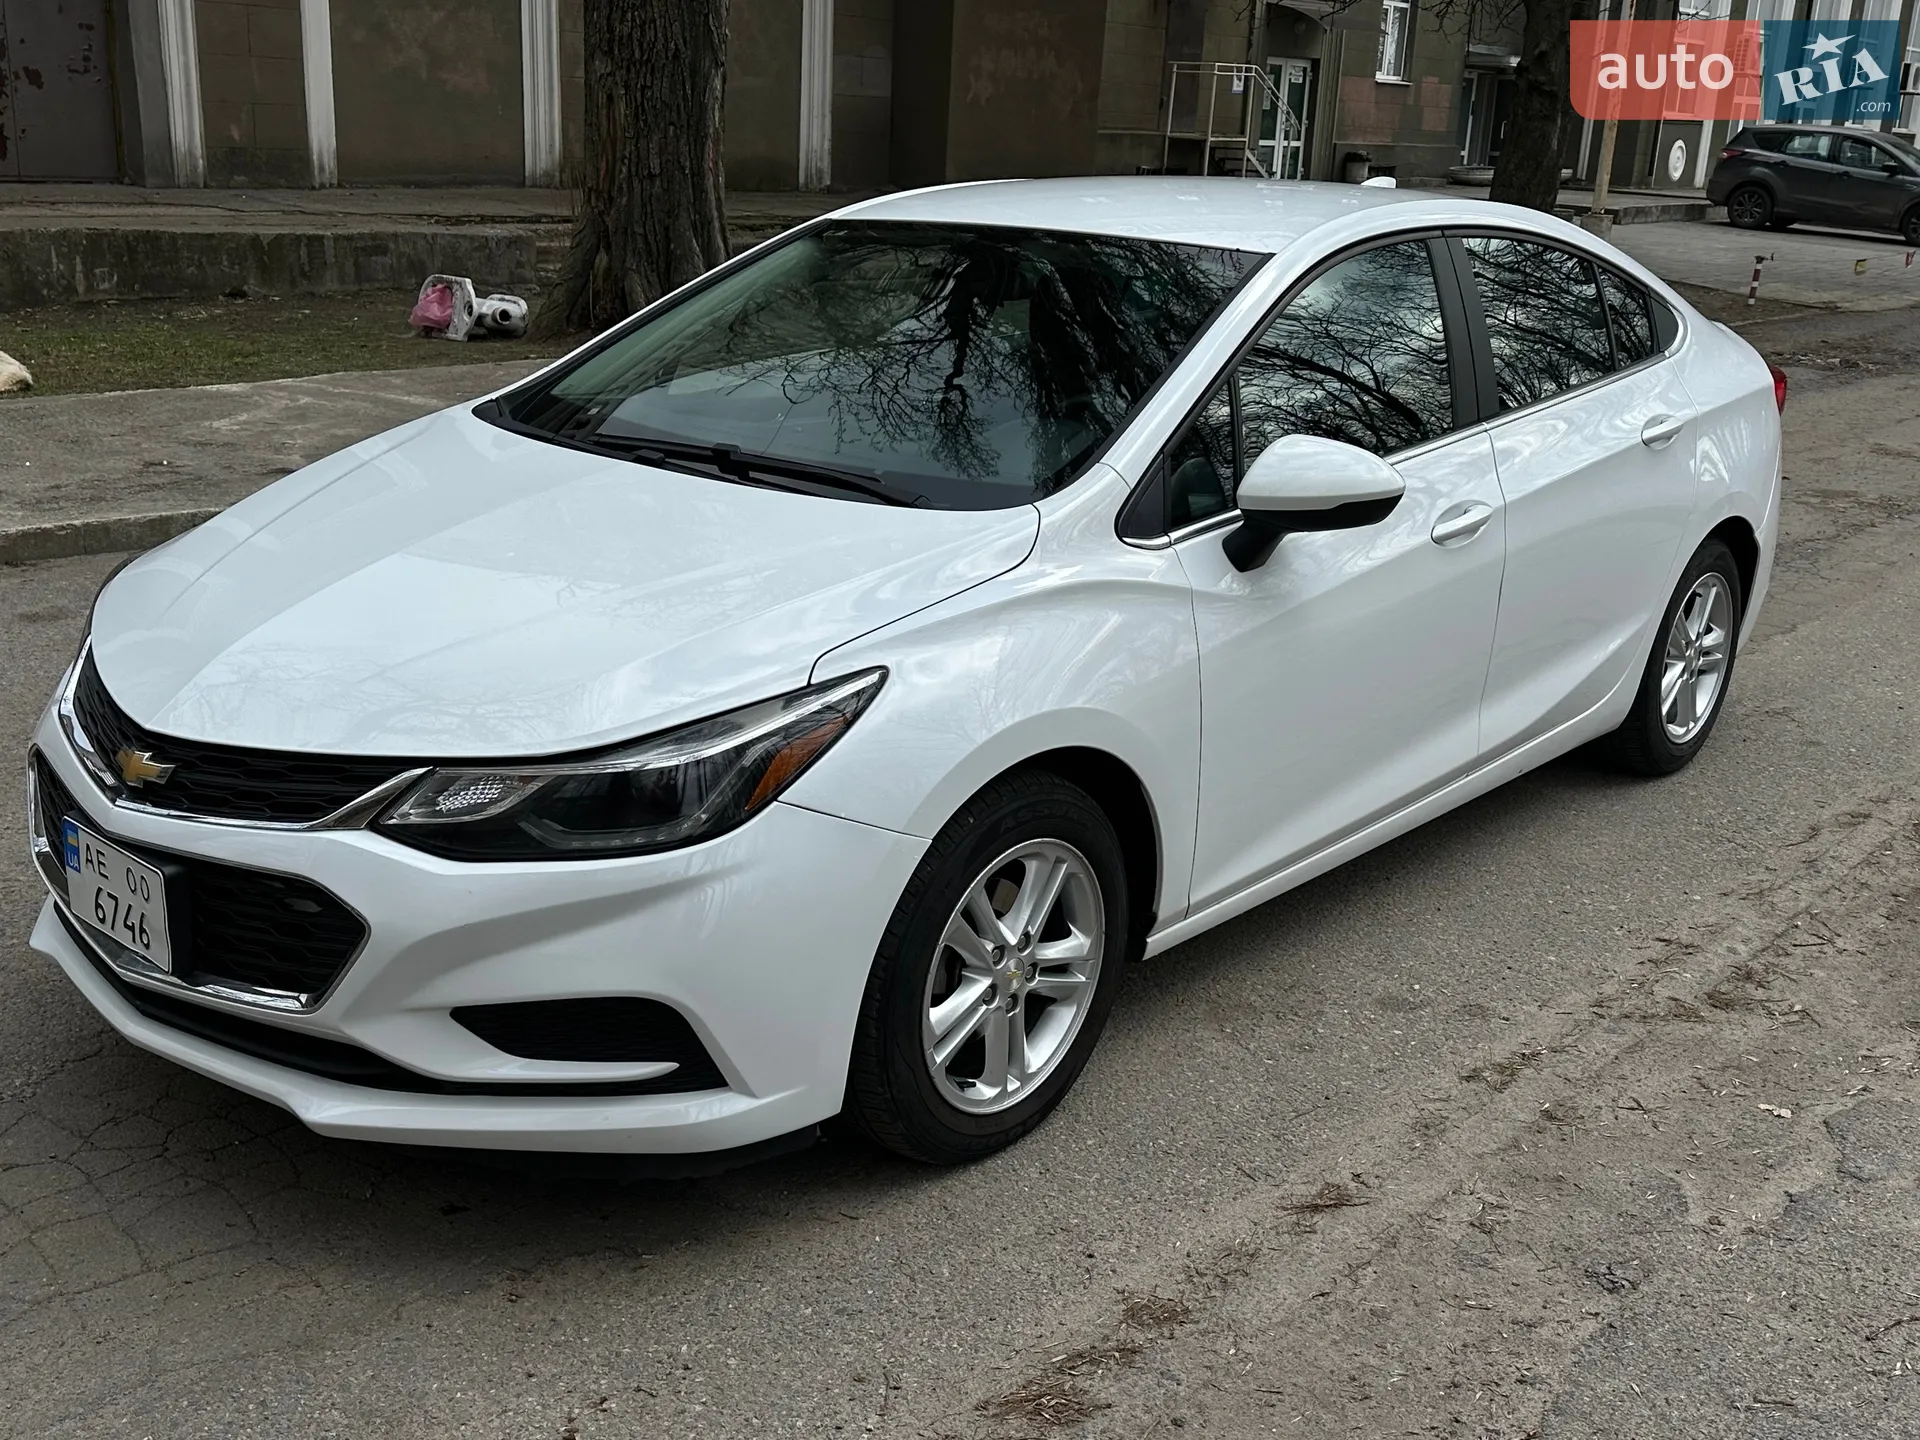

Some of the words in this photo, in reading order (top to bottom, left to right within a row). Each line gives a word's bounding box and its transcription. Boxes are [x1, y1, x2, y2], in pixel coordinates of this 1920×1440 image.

[67, 851, 80, 869] UA
[85, 842, 109, 880] AE
[126, 866, 150, 902] 00
[94, 885, 150, 950] 6746
